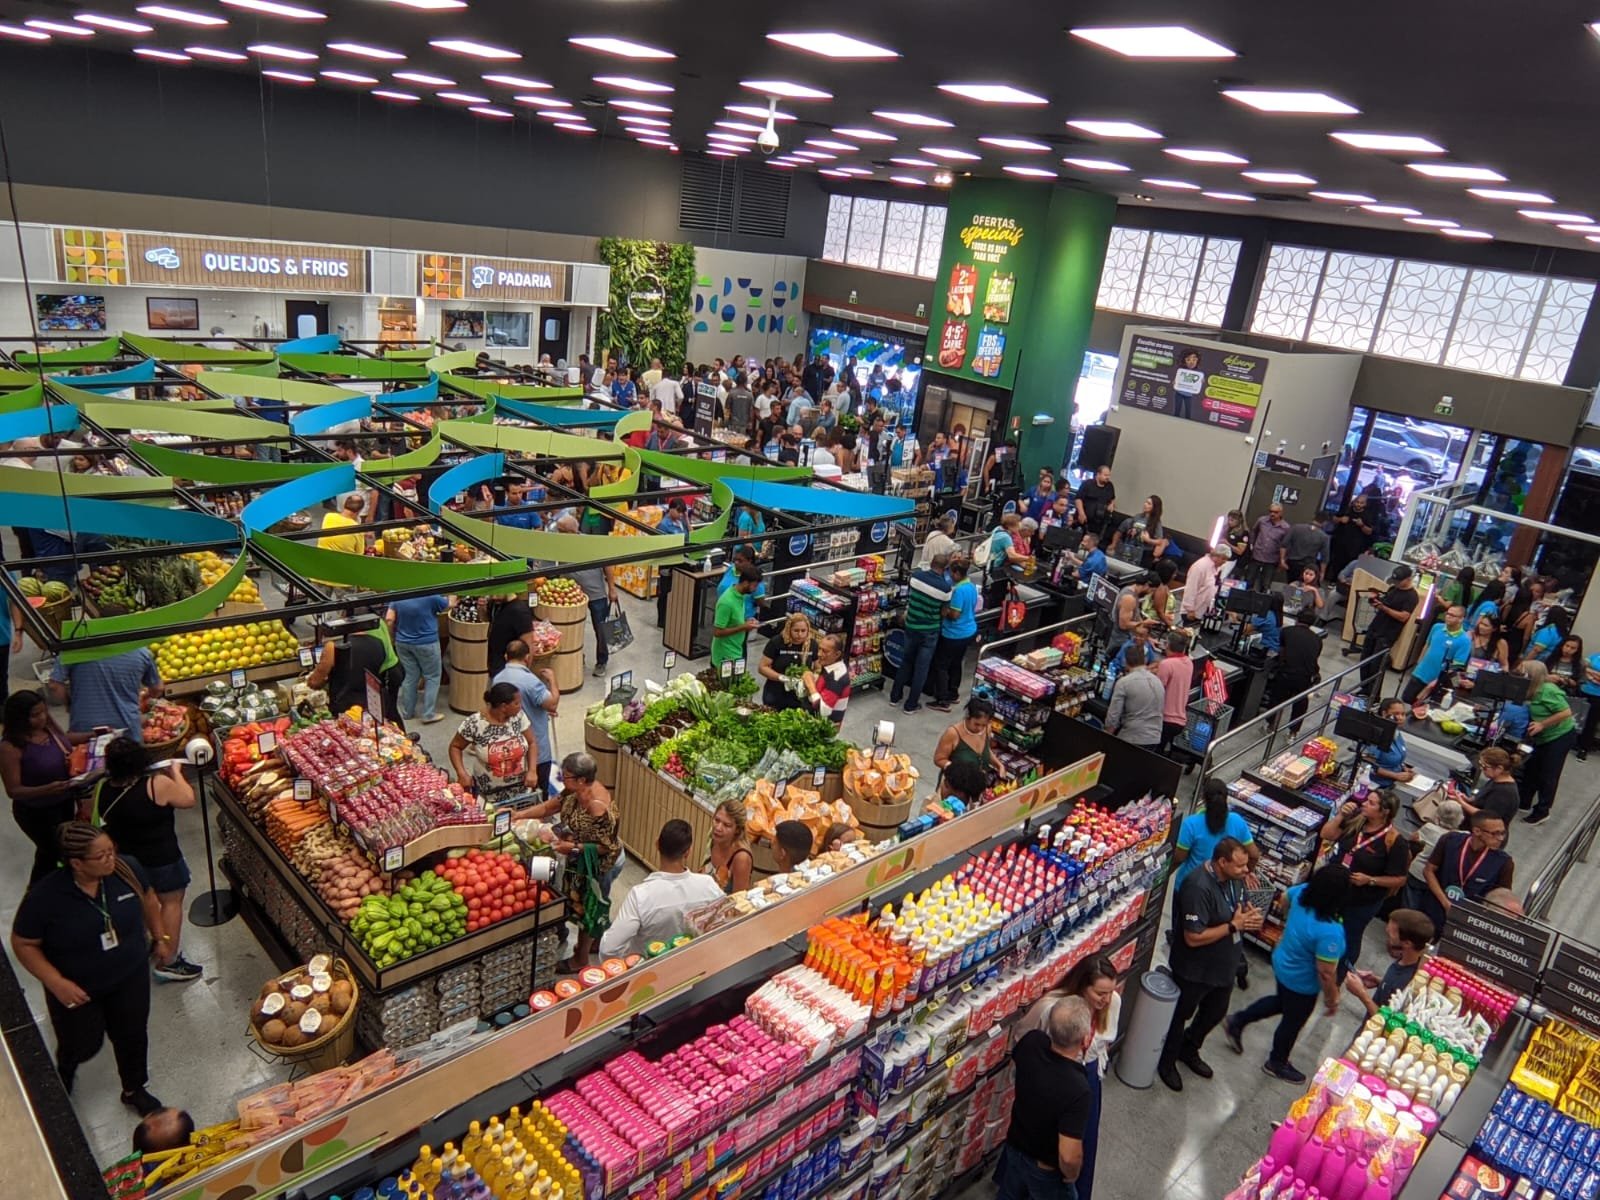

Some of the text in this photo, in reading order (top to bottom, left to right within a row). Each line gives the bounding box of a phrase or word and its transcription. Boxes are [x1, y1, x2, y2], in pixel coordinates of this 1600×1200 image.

[960, 226, 1024, 248] especiais
[204, 252, 349, 277] QUEIJOS & FRIOS
[498, 271, 552, 288] PADARIA
[1447, 889, 1460, 901] 01
[1467, 915, 1525, 946] PERFUMARIA
[1453, 929, 1529, 967] HIGIENE PESSOAL
[1466, 954, 1504, 976] LIMPEZA
